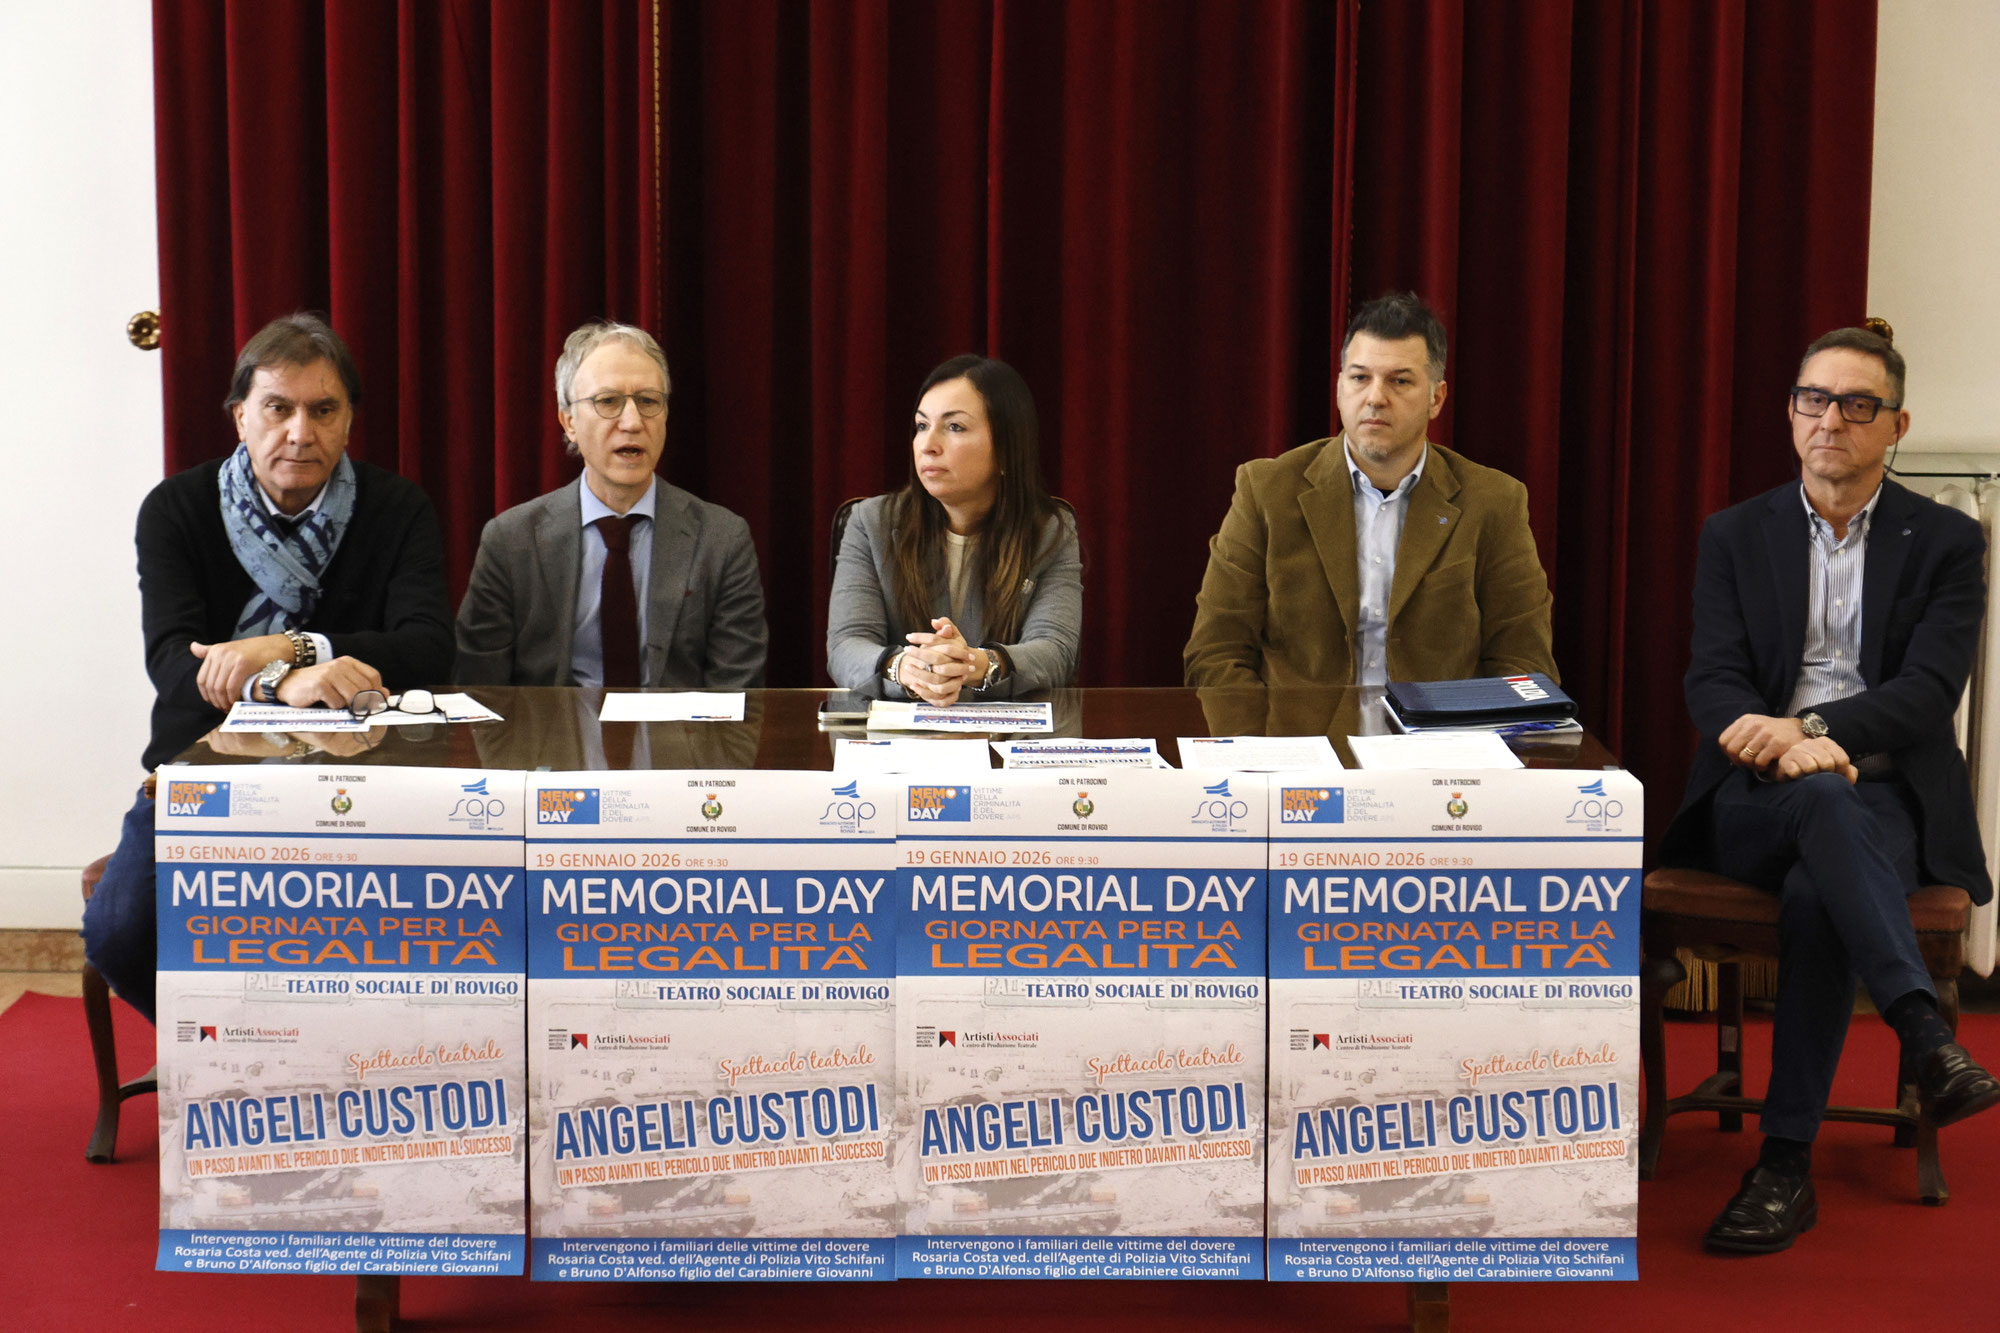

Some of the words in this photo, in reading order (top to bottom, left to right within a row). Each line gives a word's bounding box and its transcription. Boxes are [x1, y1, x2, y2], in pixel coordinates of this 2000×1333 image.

[171, 794, 205, 804] RIAL
[540, 801, 574, 811] RIAL
[910, 798, 945, 808] RIAL
[1283, 800, 1318, 811] RIAL
[169, 803, 202, 815] DAY
[539, 811, 572, 822] DAY
[910, 808, 942, 819] DAY
[1283, 810, 1316, 822] DAY
[166, 847, 185, 860] 19
[190, 847, 265, 860] GENNAIO
[271, 847, 310, 860] 2026
[315, 853, 334, 861] ORE
[537, 855, 555, 868] 19
[561, 854, 636, 867] GENNAIO
[642, 853, 681, 867] 2026
[686, 859, 705, 867] ORE
[708, 859, 728, 867] 9:30
[907, 852, 925, 865] 19
[931, 852, 1006, 865] GENNAIO
[1012, 851, 1051, 864] 2026
[1056, 857, 1075, 865] ORE
[1078, 857, 1098, 865] 9:30
[1279, 854, 1298, 867] 19
[1304, 853, 1380, 867] GENNAIO
[1385, 852, 1424, 866] 2026
[1430, 858, 1450, 866] ORE
[173, 871, 412, 907] MEMORIAL
[426, 873, 514, 909] DAY
[542, 878, 782, 914] MEMORIAL
[797, 877, 885, 913] DAY
[912, 875, 1152, 912] MEMORIAL
[1167, 876, 1255, 912] DAY
[1285, 876, 1526, 913] MEMORIAL
[1541, 875, 1629, 911] DAY
[186, 916, 365, 935] GIORNATA
[380, 918, 446, 936] PER
[459, 918, 501, 936] LA
[556, 923, 736, 942] GIORNATA
[751, 923, 817, 941] PER
[829, 923, 871, 941] LA
[925, 920, 1105, 939] GIORNATA
[1119, 921, 1186, 939] PER
[1198, 921, 1241, 939] LA
[1298, 922, 1479, 941] GIORNATA
[1493, 921, 1560, 939] PER
[1572, 921, 1615, 939] LA
[194, 937, 497, 964] LEGALITÀ
[563, 944, 867, 970] LEGALITÀ
[932, 941, 1237, 968] LEGALITÀ
[1305, 942, 1611, 969] LEGALITÀ
[287, 980, 349, 993] TEATRO
[356, 980, 425, 995] SOCIALE
[431, 981, 448, 994] DI
[454, 981, 518, 996] ROVIGO
[658, 987, 720, 1000] TEATRO
[726, 986, 796, 1001] SOCIALE
[802, 986, 819, 1000] DI
[826, 986, 889, 1000] ROVIGO
[1026, 984, 1089, 998] TEATRO
[1095, 984, 1165, 998] SOCIALE
[1171, 984, 1188, 998] DI
[1194, 984, 1258, 999] ROVIGO
[1399, 986, 1462, 999] TEATRO
[1469, 984, 1539, 999] SOCIALE
[1545, 985, 1562, 998] DI
[1568, 984, 1633, 999] ROVIGO
[348, 1045, 433, 1082] Spettacolo
[440, 1039, 505, 1064] teatrale
[720, 1051, 805, 1088] Spettacolo
[811, 1045, 877, 1070] teatrale
[1088, 1049, 1173, 1086] Spettacolo
[1179, 1044, 1245, 1068] teatrale
[1461, 1050, 1547, 1087] Spettacolo
[1553, 1044, 1619, 1068] teatrale
[185, 1093, 326, 1151] ANGELI
[337, 1079, 507, 1140] CUSTODI
[555, 1101, 697, 1159] ANGELI
[708, 1085, 879, 1146] CUSTODI
[922, 1098, 1063, 1156] ANGELI
[1075, 1083, 1246, 1144] CUSTODI
[1294, 1101, 1437, 1159] ANGELI
[1449, 1084, 1620, 1145] CUSTODI
[189, 1159, 202, 1175] UN
[204, 1157, 235, 1174] PASSO
[238, 1155, 272, 1172] AVANTI
[274, 1154, 292, 1170] NEL
[294, 1150, 339, 1168] PERICOLO
[342, 1149, 359, 1164] DUE
[362, 1146, 404, 1163] INDIETRO
[407, 1142, 447, 1160] DAVANTI
[450, 1141, 462, 1157] AL
[464, 1137, 511, 1156] SUCCESSO
[1300, 1243, 1387, 1254] Intervengono
[1391, 1242, 1394, 1252] i
[1398, 1241, 1451, 1252] familiari
[1455, 1241, 1486, 1251] delle
[1490, 1241, 1536, 1251] vittime
[1540, 1241, 1560, 1251] del
[1564, 1241, 1609, 1251] dovere
[1285, 1255, 1332, 1266] Rosaria
[1336, 1255, 1372, 1266] Costa
[1376, 1255, 1403, 1265] ved.
[1483, 1254, 1495, 1265] di
[1499, 1254, 1539, 1265] Polizia
[1543, 1254, 1570, 1264] Vito
[1574, 1254, 1624, 1265] Schifani
[1296, 1270, 1304, 1278] e
[1308, 1268, 1347, 1278] Bruno
[1352, 1267, 1414, 1278] D'Alfonso
[1418, 1267, 1449, 1279] figlio
[1453, 1267, 1473, 1277] del
[1477, 1267, 1551, 1277] Carabiniere
[1556, 1267, 1613, 1277] Giovanni
